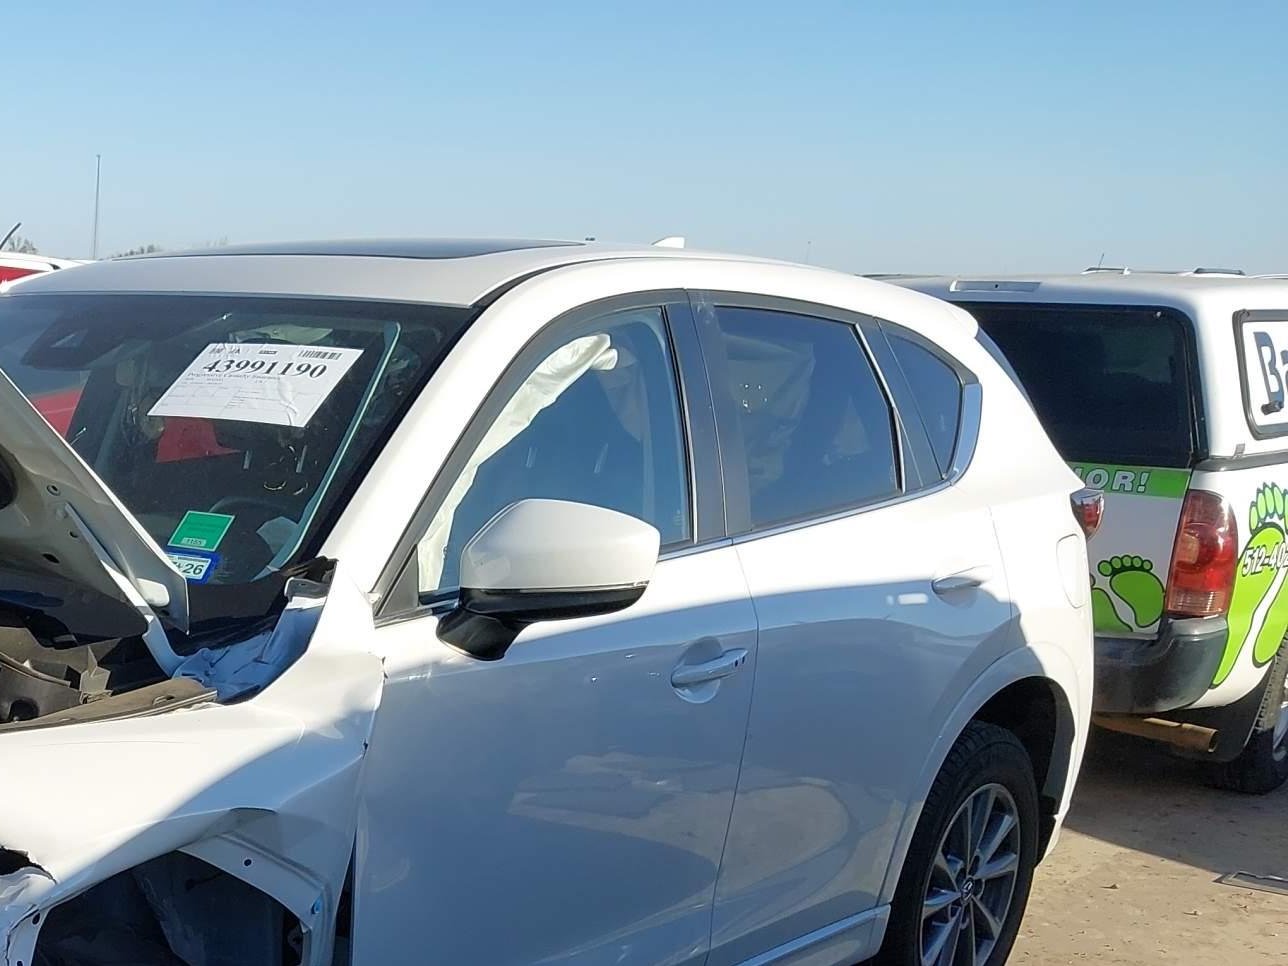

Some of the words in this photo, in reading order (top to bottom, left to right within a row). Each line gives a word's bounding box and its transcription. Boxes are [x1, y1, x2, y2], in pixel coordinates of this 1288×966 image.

[203, 359, 328, 379] 43991190
[1073, 467, 1150, 493] OR!
[182, 563, 205, 576] 26
